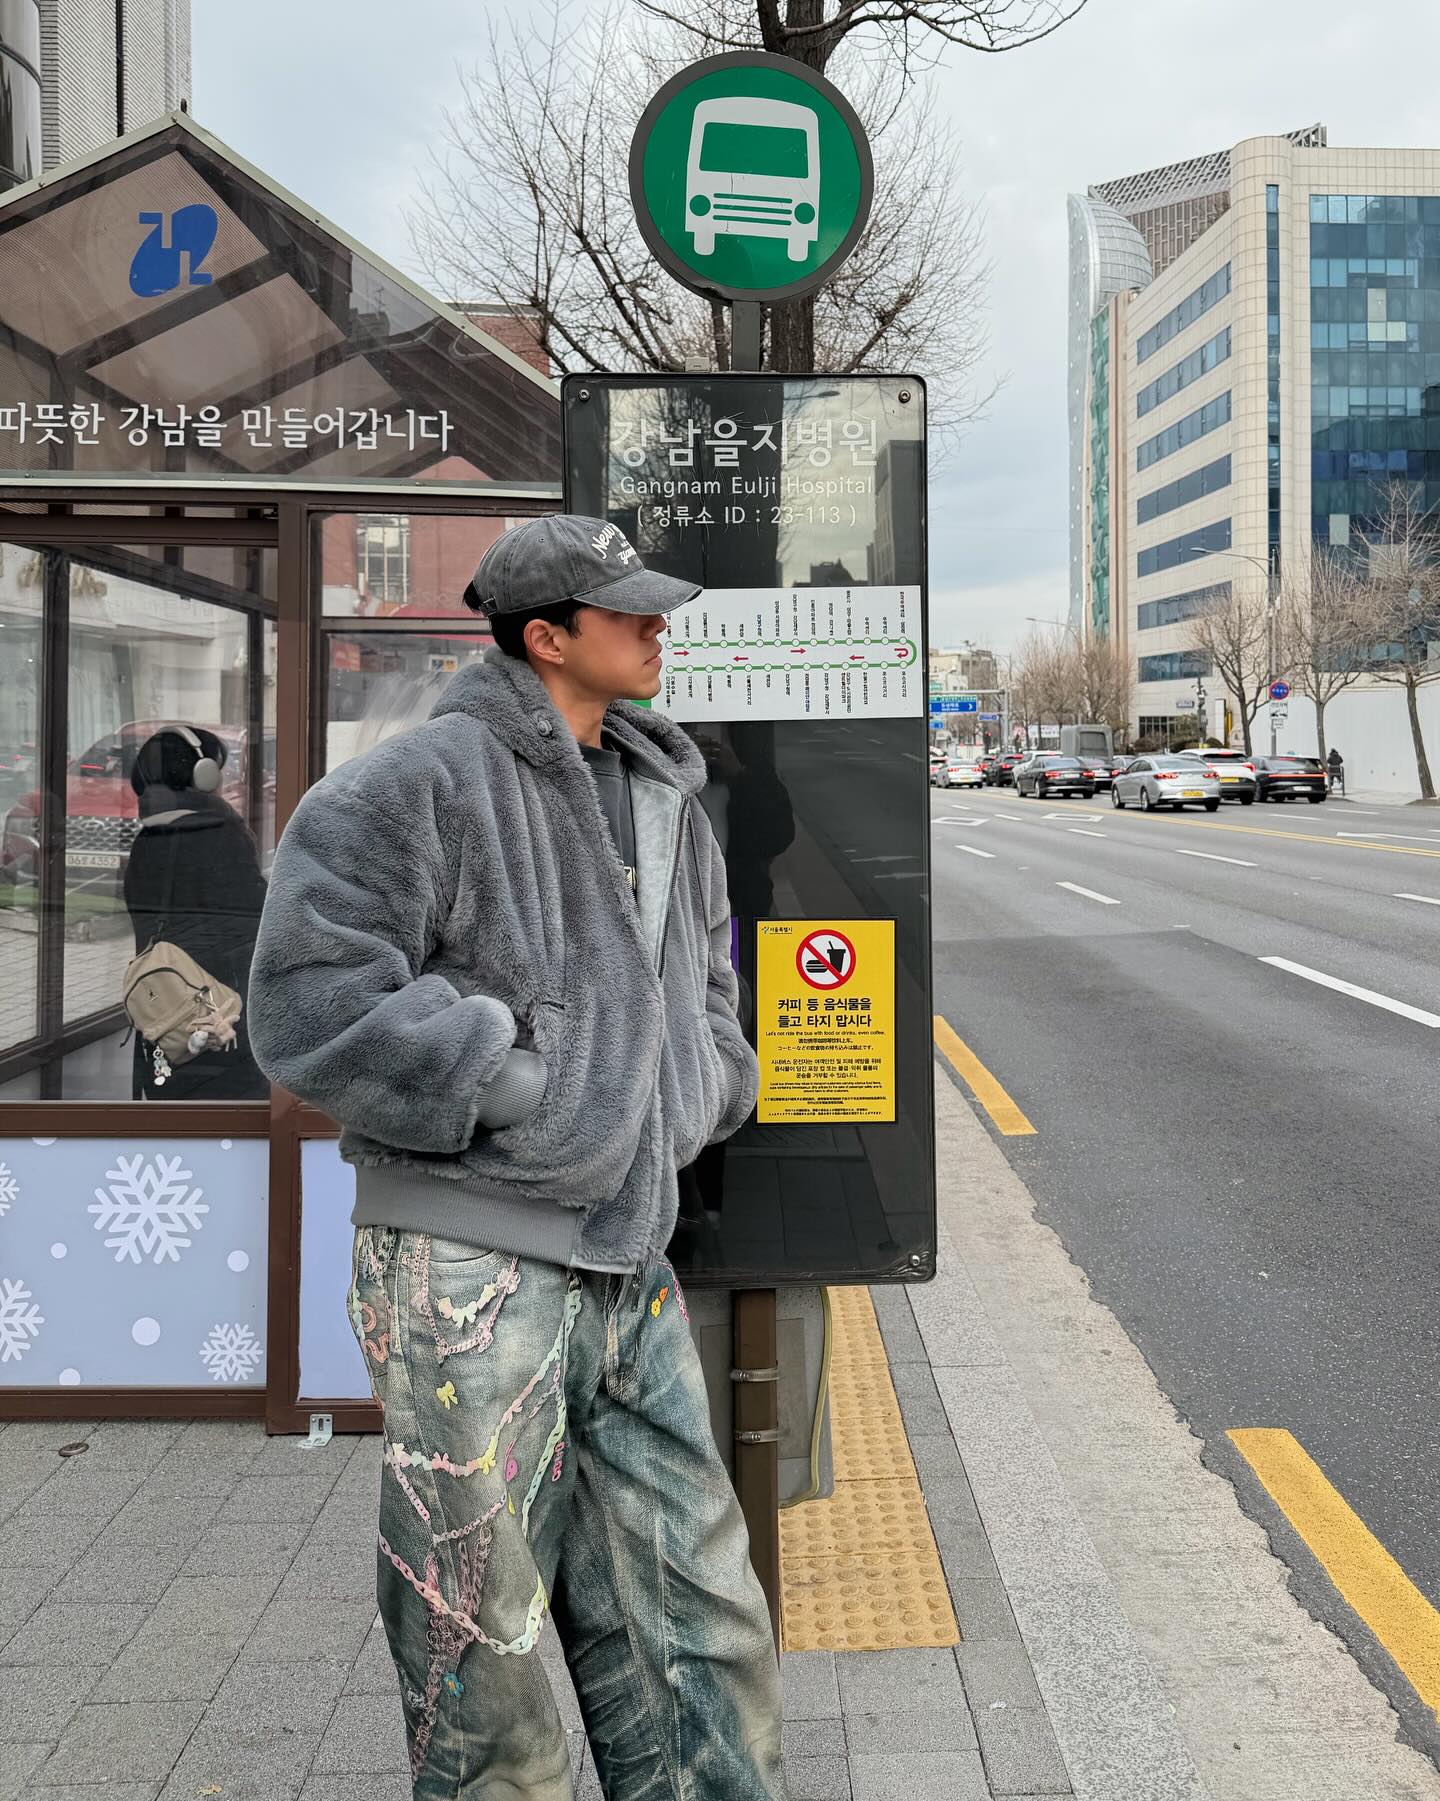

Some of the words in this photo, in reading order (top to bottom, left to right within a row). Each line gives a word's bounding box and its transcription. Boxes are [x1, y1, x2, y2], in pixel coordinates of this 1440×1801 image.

[0, 402, 105, 446] 따뜻한
[118, 404, 228, 449] 강남을
[242, 407, 454, 452] 만들어갑니다
[612, 418, 878, 468] 강남을지병원
[620, 476, 721, 498] Gangnam
[732, 475, 777, 498] Eulji
[787, 475, 873, 497] Hospital
[654, 505, 716, 527] 정류소
[725, 506, 746, 523] ID
[770, 506, 841, 523] 23-113
[591, 525, 615, 560] New
[777, 998, 801, 1012] 커피
[807, 998, 819, 1011] 등
[823, 998, 871, 1011] 음식물을
[777, 1015, 802, 1028] 들고
[807, 1014, 831, 1027] 타지
[836, 1014, 872, 1027] 맙시다
